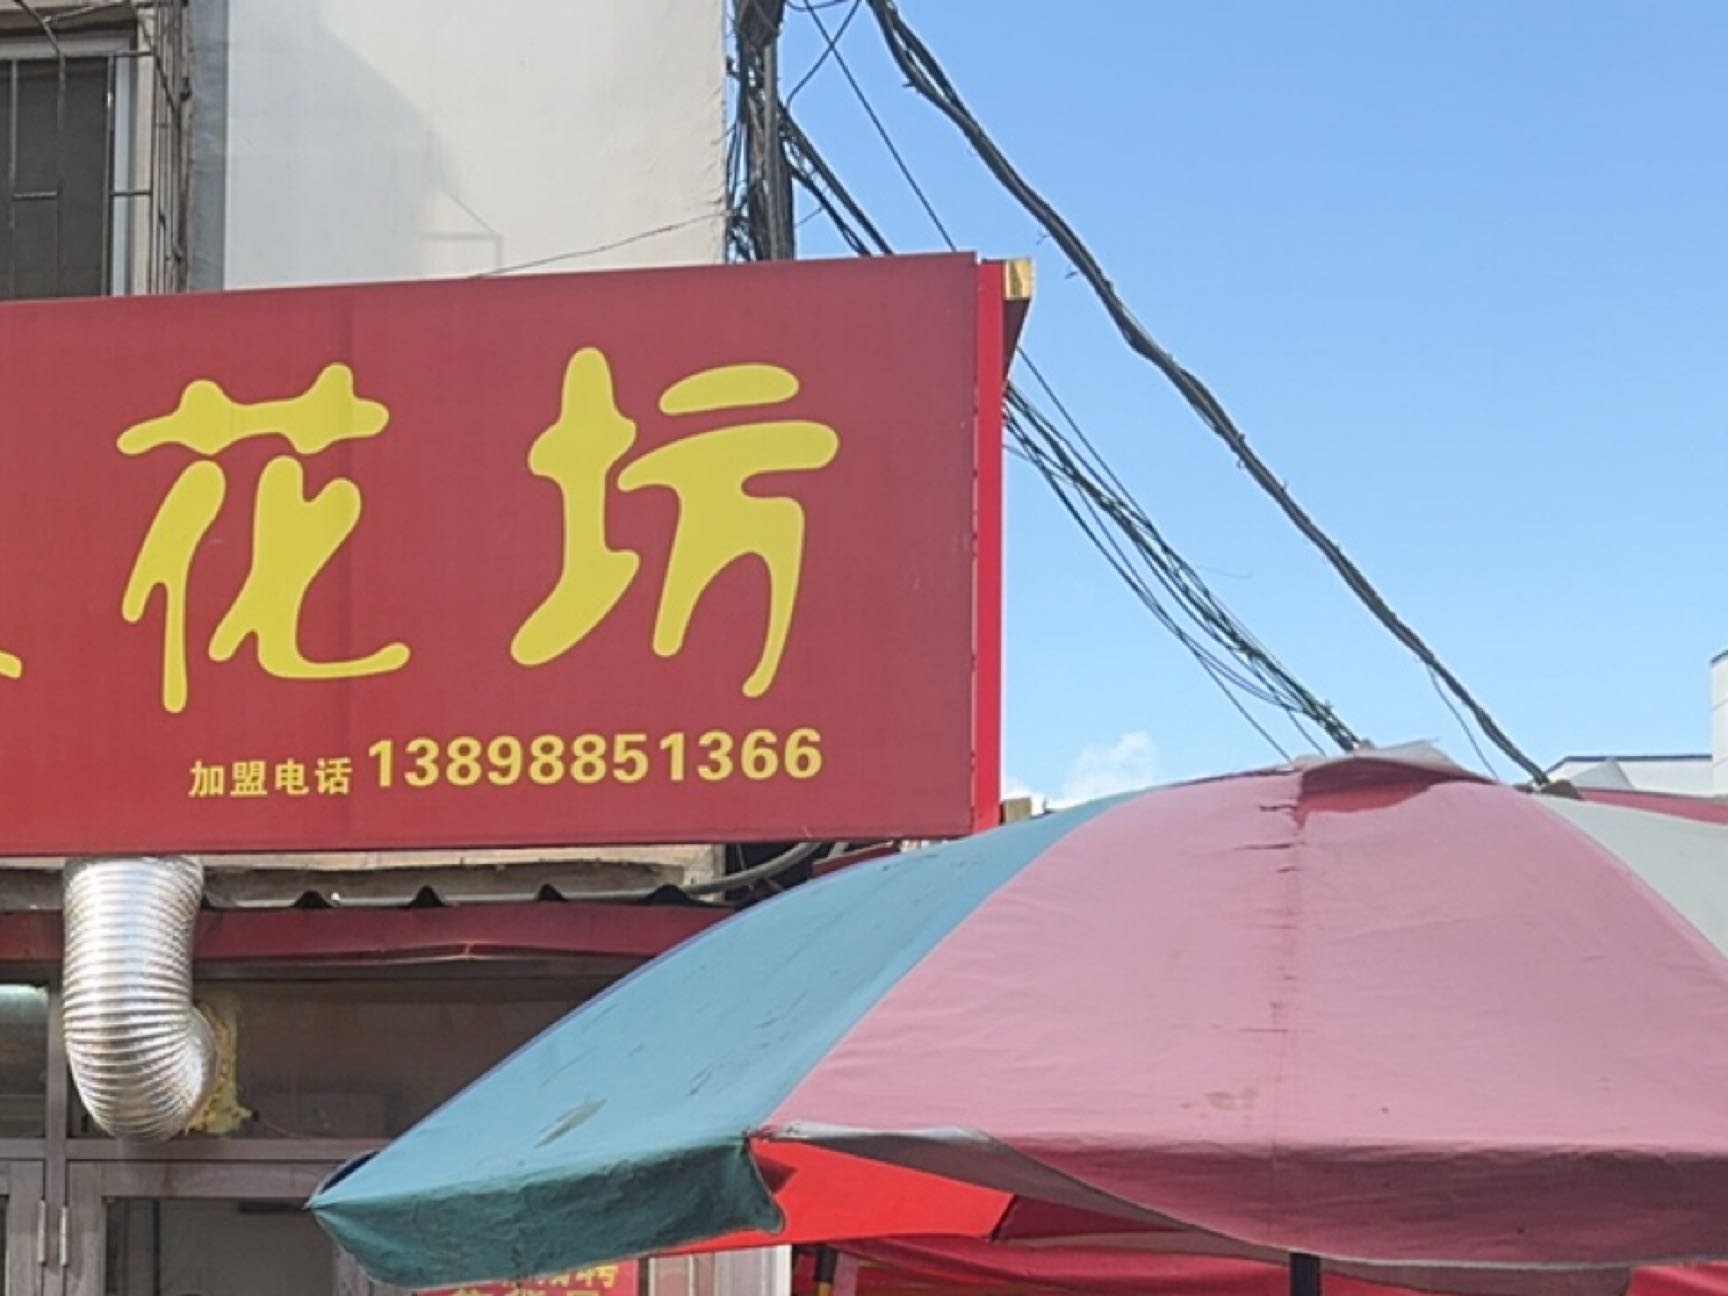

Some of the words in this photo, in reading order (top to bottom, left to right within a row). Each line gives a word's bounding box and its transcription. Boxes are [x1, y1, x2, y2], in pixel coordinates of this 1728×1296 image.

[188, 757, 355, 798] 加盟电话
[368, 727, 825, 788] 13898851366
